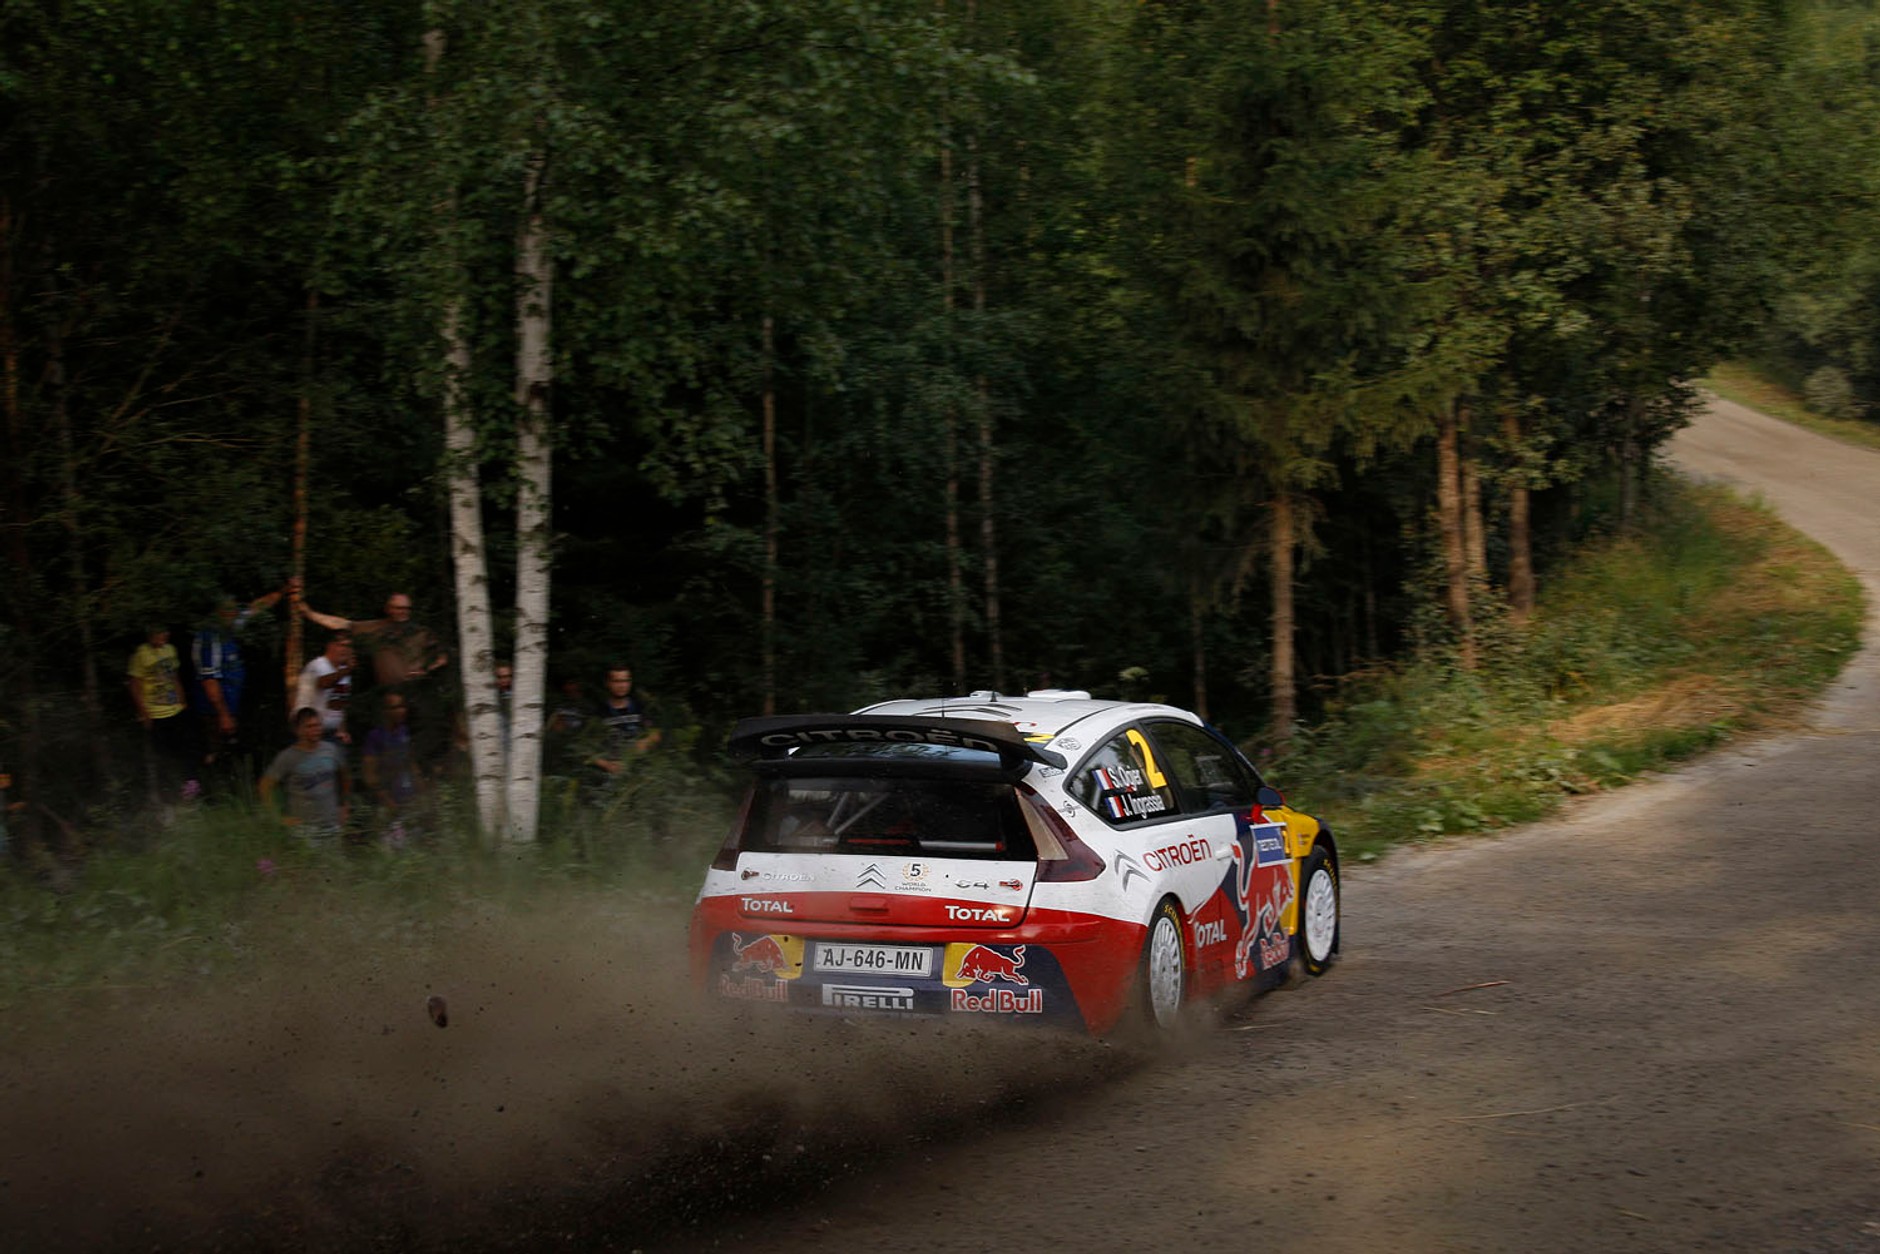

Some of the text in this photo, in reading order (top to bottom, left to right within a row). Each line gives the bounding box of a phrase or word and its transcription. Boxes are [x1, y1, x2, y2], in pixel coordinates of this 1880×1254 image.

[761, 728, 998, 751] CITROËN
[1126, 729, 1167, 789] 2
[1118, 765, 1144, 791] Ogier
[1142, 834, 1212, 872] CITROËN
[910, 863, 921, 877] 5
[741, 897, 793, 913] TOTAL
[944, 905, 1010, 922] TOTAL
[823, 948, 923, 970] AJ-646-MN
[822, 983, 914, 1010] PIRELLI
[951, 988, 1042, 1013] Red Bull
